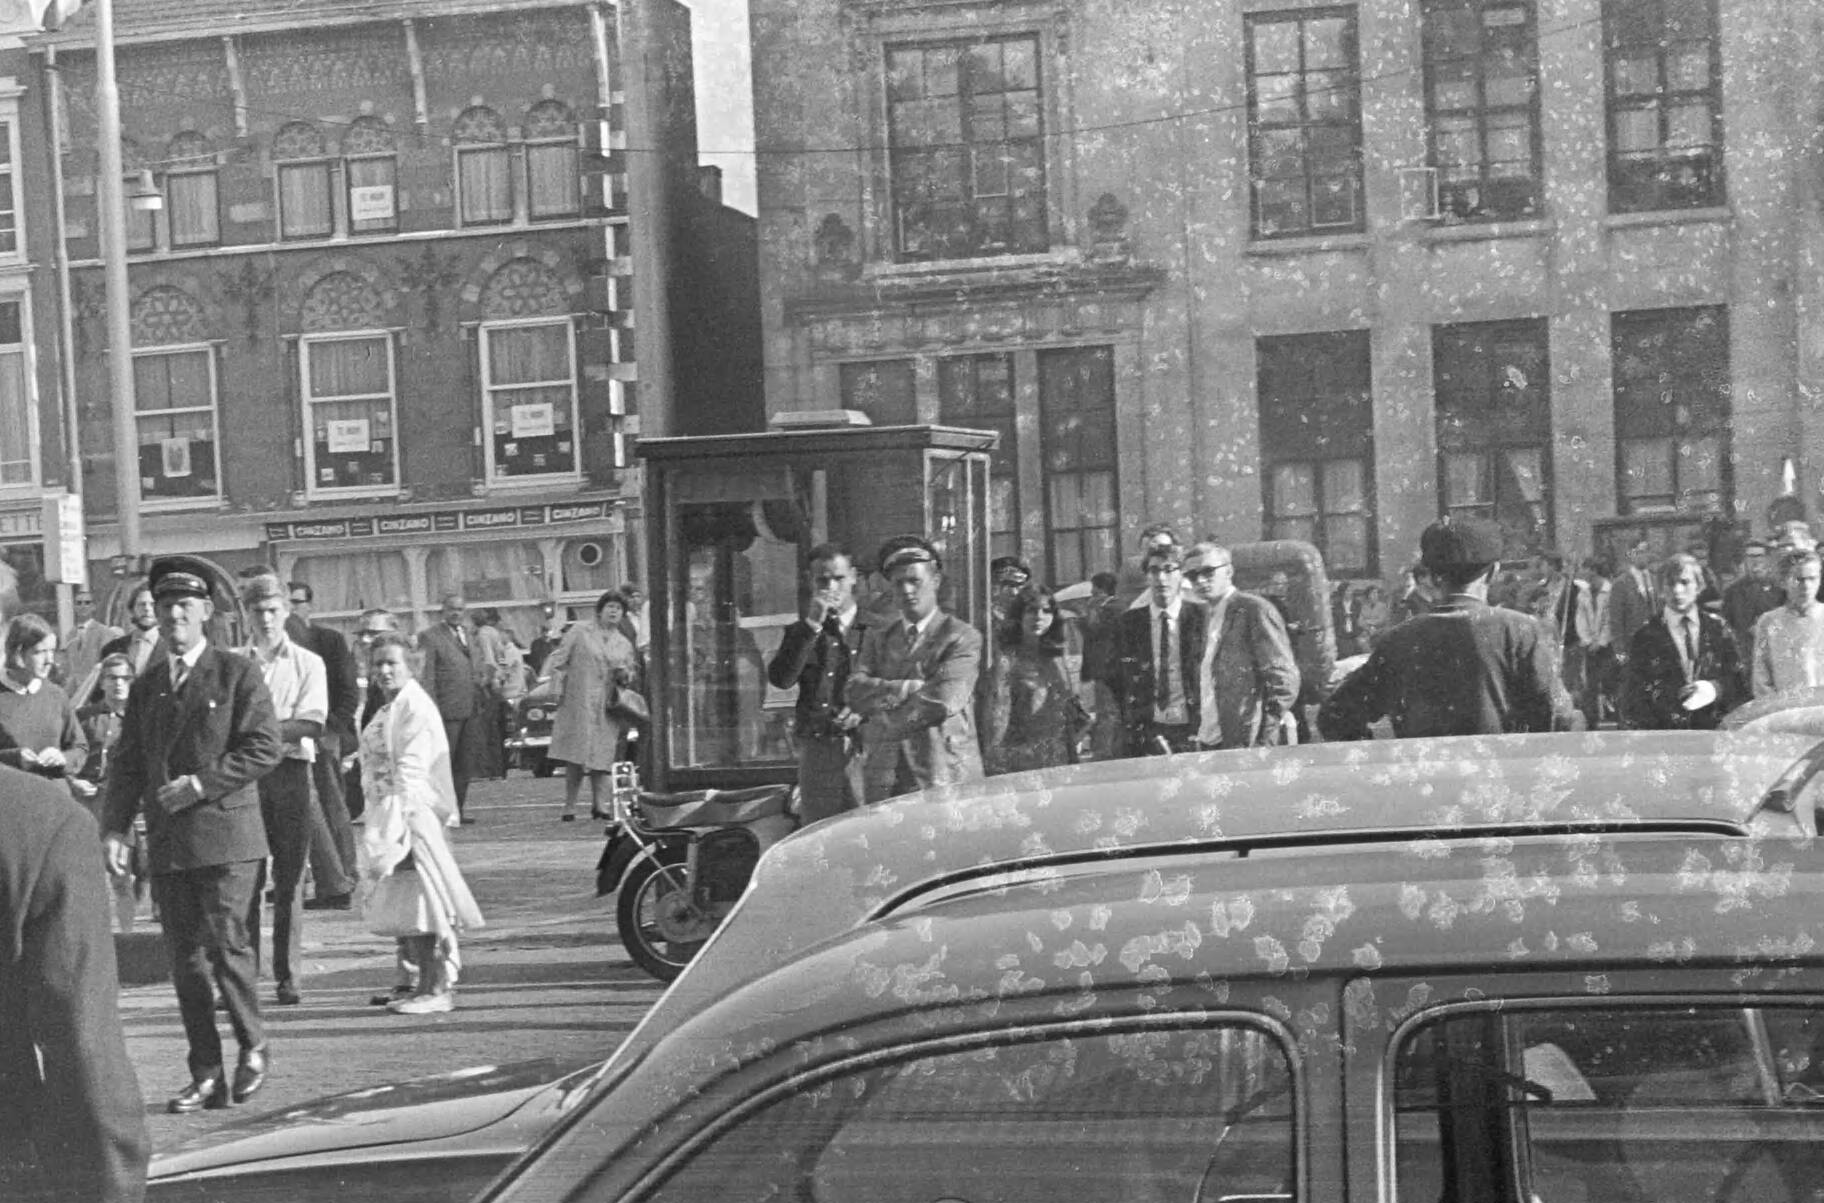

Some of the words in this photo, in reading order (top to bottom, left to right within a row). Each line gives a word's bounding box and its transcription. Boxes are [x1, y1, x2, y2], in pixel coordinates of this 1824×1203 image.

[466, 512, 515, 525] CINZANO
[553, 506, 601, 519] CINZANO
[295, 524, 344, 537] CINZANO
[380, 518, 429, 530] CINZANO
